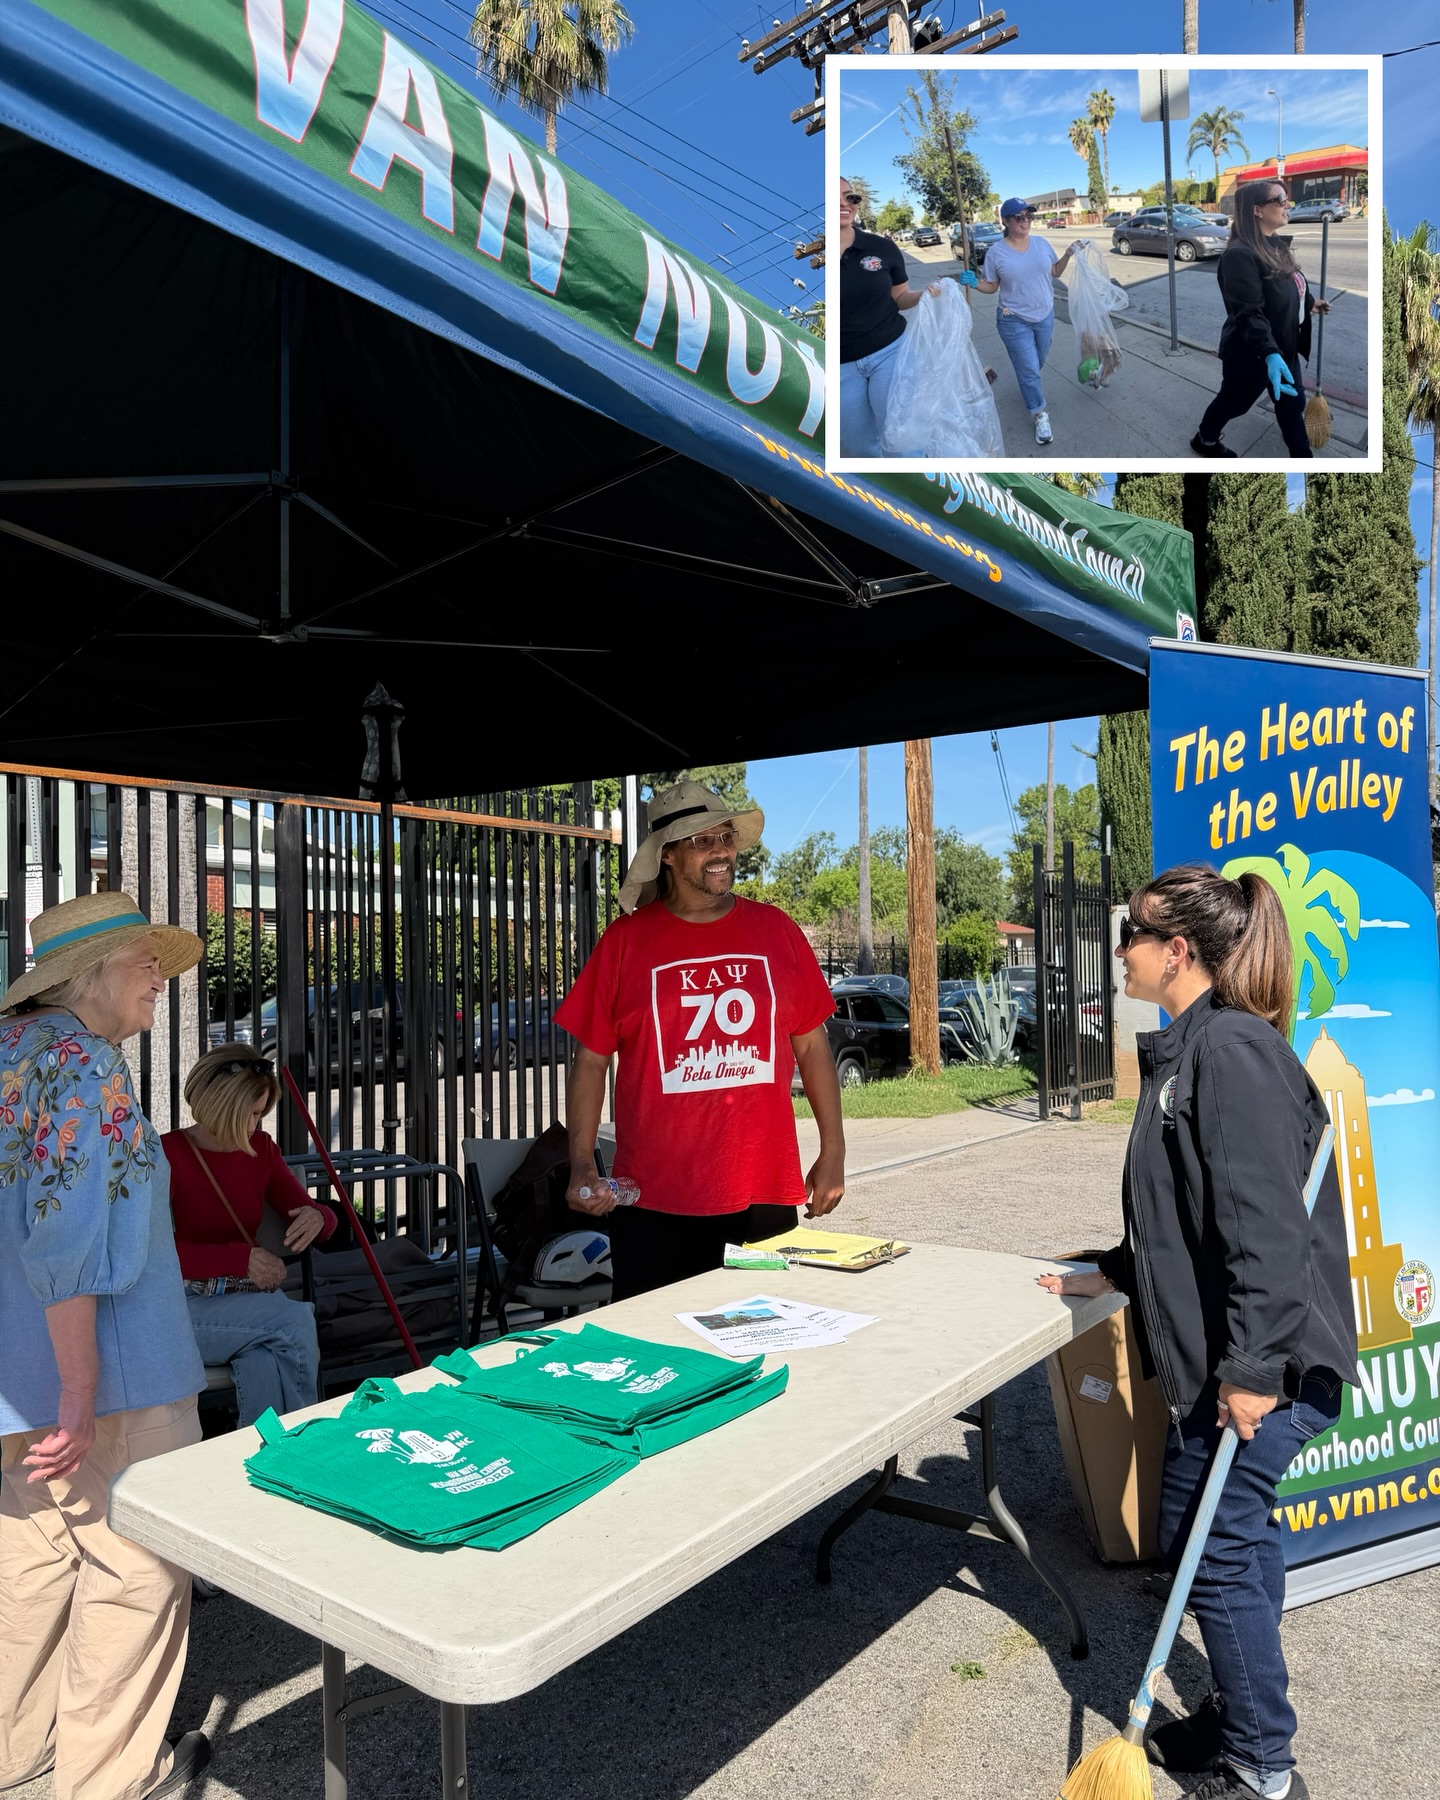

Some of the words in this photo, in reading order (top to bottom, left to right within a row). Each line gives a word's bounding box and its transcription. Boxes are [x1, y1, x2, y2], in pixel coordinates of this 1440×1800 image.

[245, 0, 569, 295] VAN
[633, 230, 825, 438] NUY
[1071, 527, 1146, 605] Council
[1169, 725, 1246, 793] The
[1259, 698, 1367, 762] Heart
[1377, 706, 1415, 754] of
[1208, 788, 1278, 850] the
[1289, 758, 1403, 823] Valley
[680, 988, 756, 1041] 70
[682, 1065, 712, 1083] Beta
[715, 1061, 756, 1080] Omega
[1352, 1341, 1440, 1418] NUY
[443, 1429, 464, 1441] VN
[455, 1436, 475, 1449] NC
[1281, 1420, 1394, 1481] borhood
[1272, 1467, 1440, 1532] w.vnnc.o
